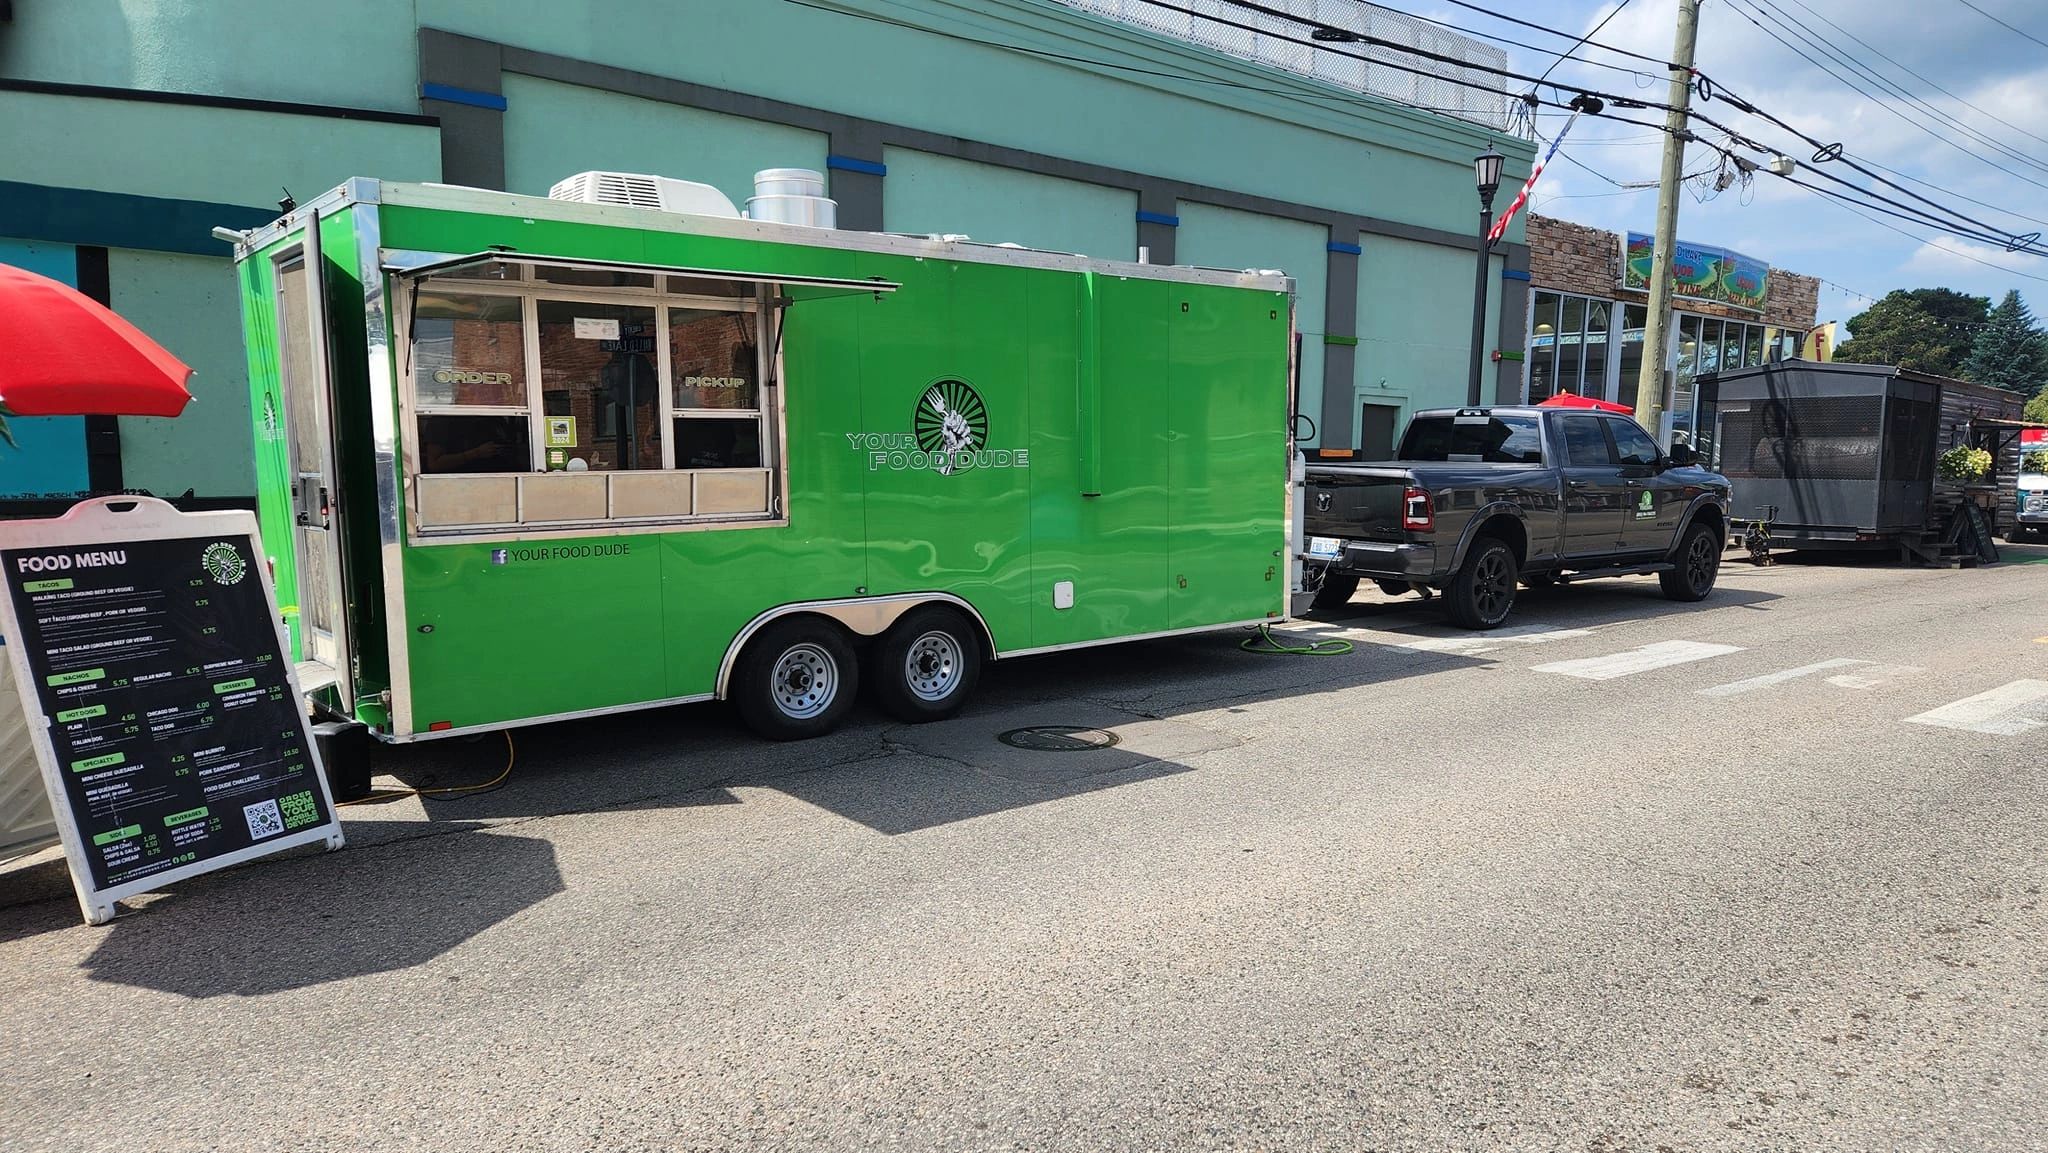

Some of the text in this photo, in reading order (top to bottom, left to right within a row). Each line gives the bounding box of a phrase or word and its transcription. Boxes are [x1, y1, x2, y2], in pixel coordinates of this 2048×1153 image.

[432, 370, 512, 384] ORDER
[685, 376, 745, 388] PICKUP
[846, 433, 918, 450] YOUR
[870, 449, 1029, 470] FOOD DUDE
[512, 548, 549, 561] YOUR
[553, 546, 590, 559] FOOD
[594, 544, 630, 557] DUDE
[17, 550, 126, 573] FOOD MENU
[256, 654, 272, 662] 10.00
[62, 673, 90, 681] NACHOS
[133, 673, 155, 682] REGULAR
[186, 667, 200, 675] 6.75
[77, 683, 98, 692] CHEESE
[112, 678, 128, 687] 5.75
[222, 681, 248, 690] DESSERTS
[146, 709, 167, 717] CHICAGO
[72, 738, 91, 746] ITALIAN
[124, 726, 139, 734] 5.75
[205, 746, 226, 754] BURRITO
[282, 730, 294, 739] 5.75
[83, 757, 114, 768] SPECIALTY
[213, 762, 240, 773] SANDWICH
[284, 748, 299, 757] 10.50
[94, 772, 113, 780] CHEESE
[113, 764, 144, 776] QUESADILLA
[98, 782, 128, 793] QUESADILLA
[175, 768, 189, 777] 5.75
[204, 784, 218, 793] FOOD
[233, 774, 260, 786] CHALLENGE
[279, 790, 311, 804] ORDER
[280, 796, 314, 810] FROM
[171, 810, 202, 822] BEVERAGES
[282, 803, 316, 817] YOUR
[285, 810, 318, 822] MOBILE
[171, 827, 189, 835] BOTTLE
[102, 845, 119, 853] SALSA
[144, 834, 156, 842] 1.00
[124, 846, 140, 855] SALSA
[121, 854, 139, 863] CREAM
[147, 848, 160, 856] 0.75
